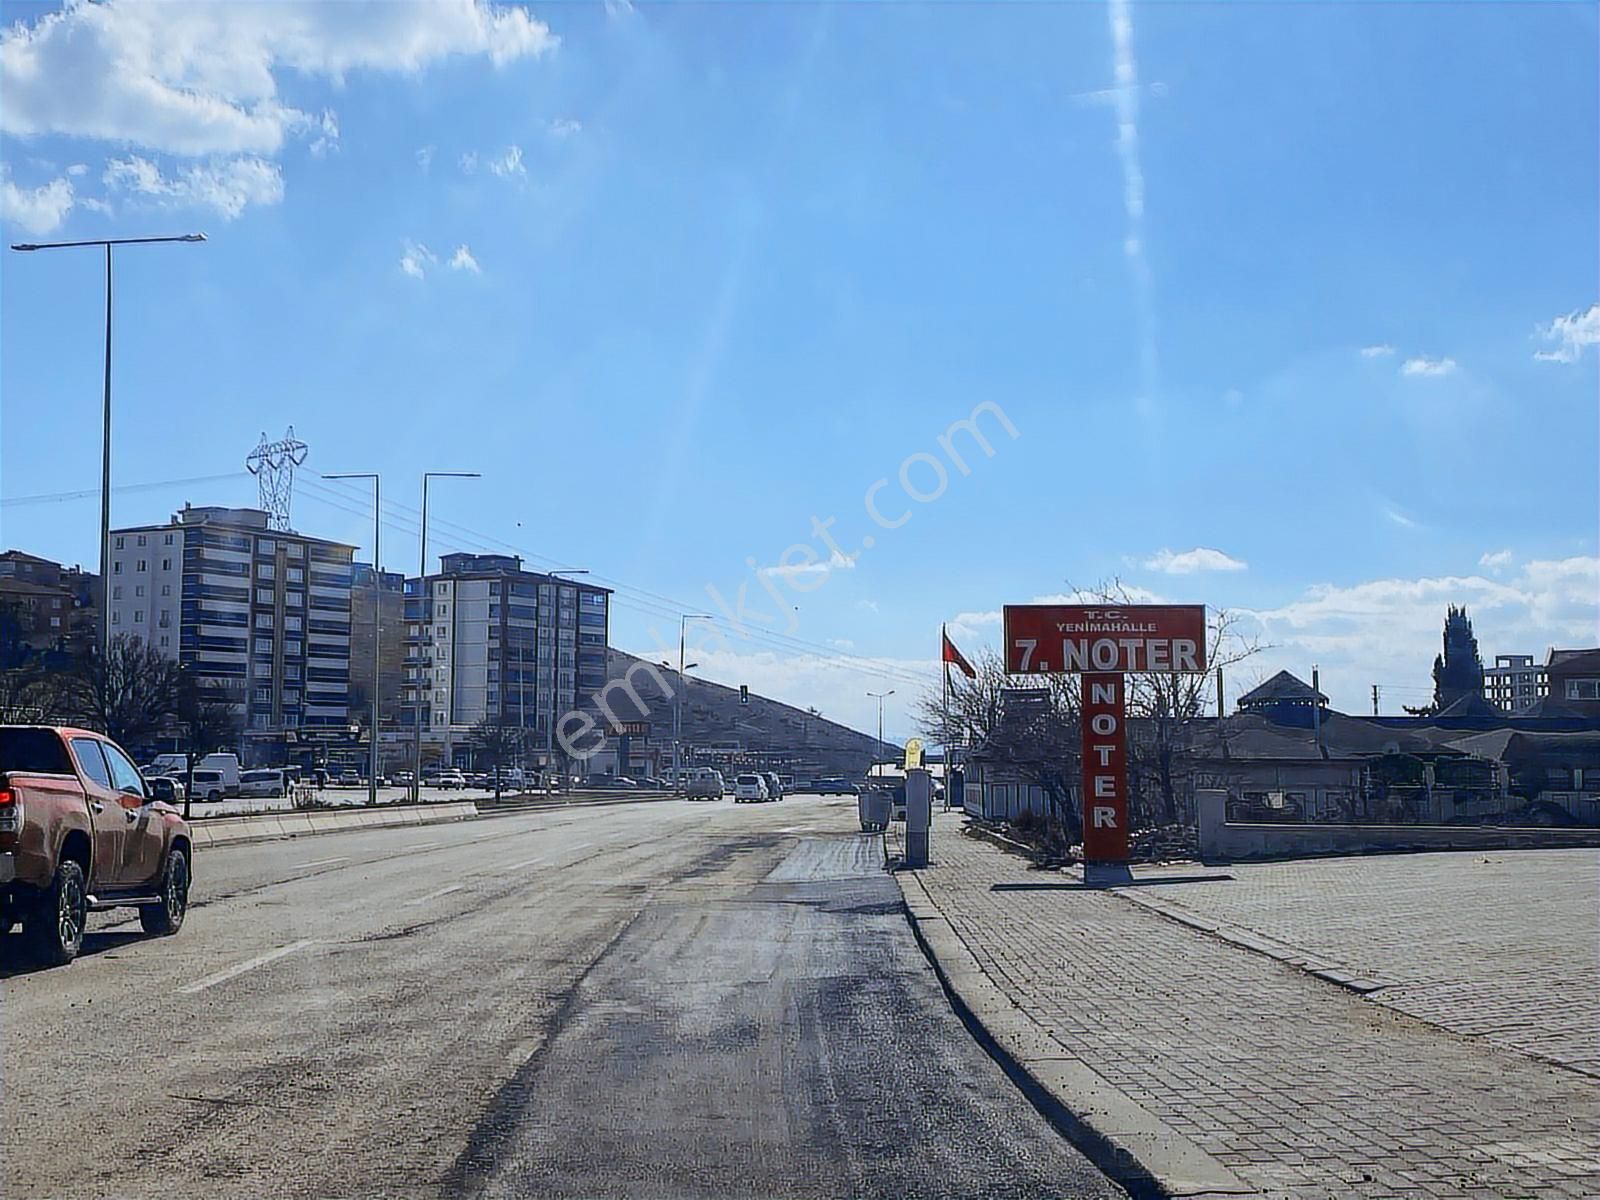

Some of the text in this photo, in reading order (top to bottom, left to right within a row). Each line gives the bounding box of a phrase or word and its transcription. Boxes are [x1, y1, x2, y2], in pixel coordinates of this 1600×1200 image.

[1057, 620, 1157, 632] YENİMAHALLE
[1084, 610, 1128, 620] T.C.
[1015, 638, 1199, 671] 7. NOTER
[1091, 683, 1117, 828] NOTER
